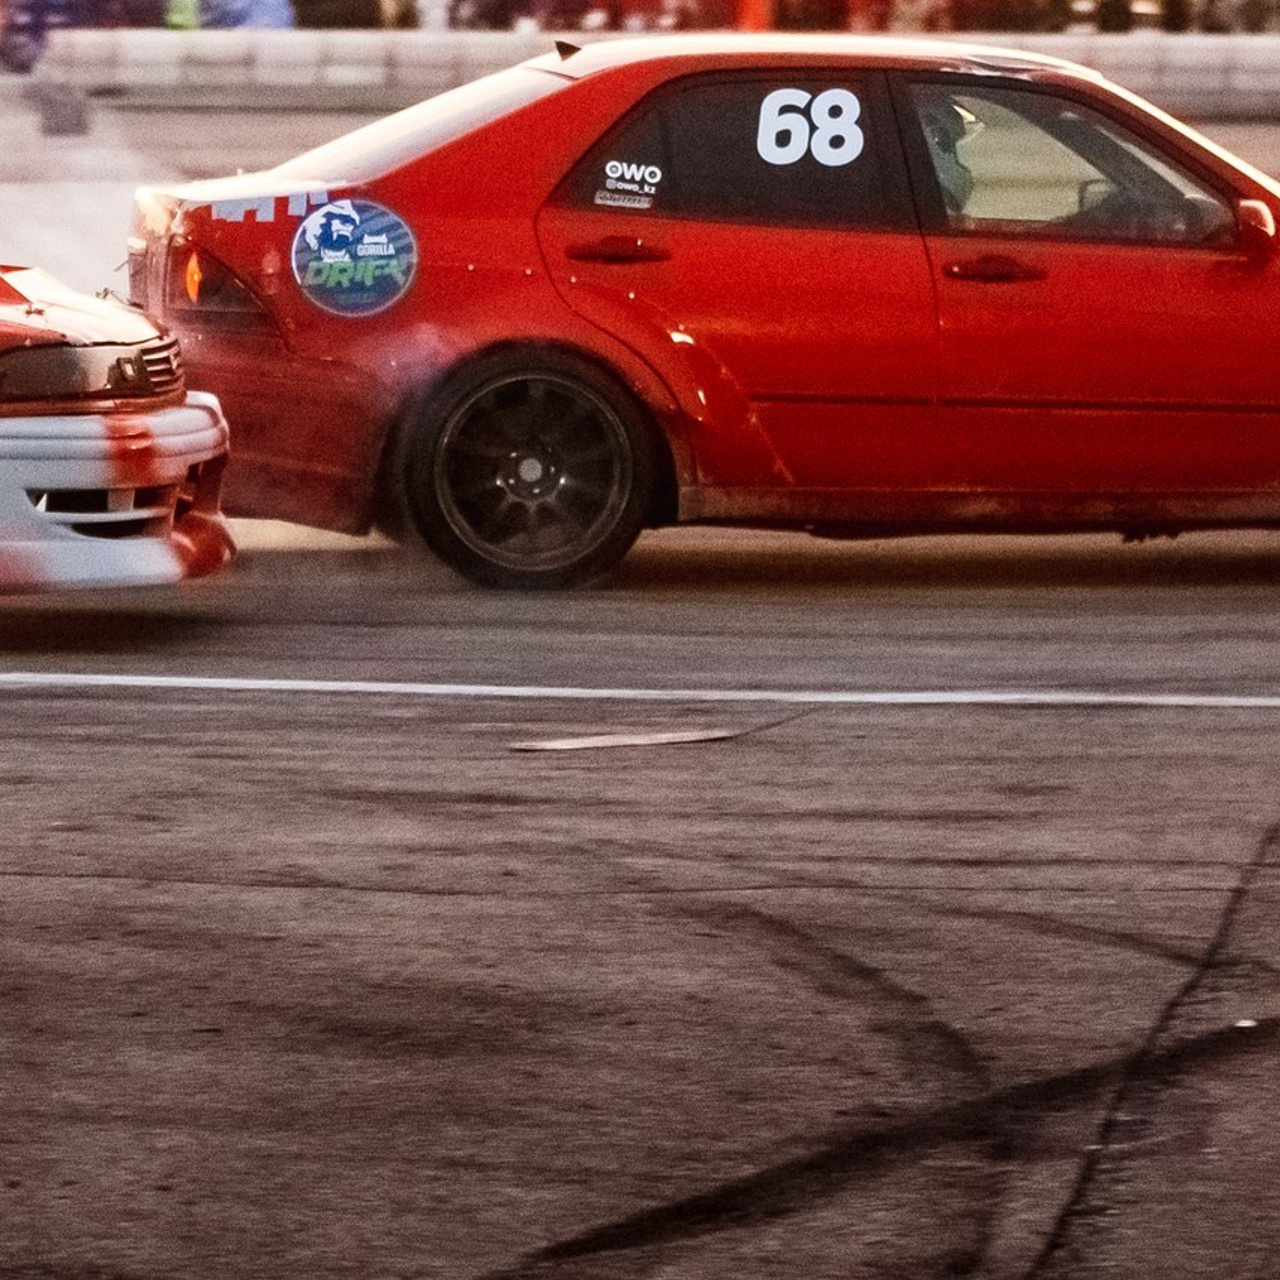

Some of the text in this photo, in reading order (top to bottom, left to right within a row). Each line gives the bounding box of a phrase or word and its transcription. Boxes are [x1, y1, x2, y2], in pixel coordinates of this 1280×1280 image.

[756, 88, 864, 167] 68
[357, 243, 395, 256] GORILLA
[302, 258, 405, 287] DRIFT
